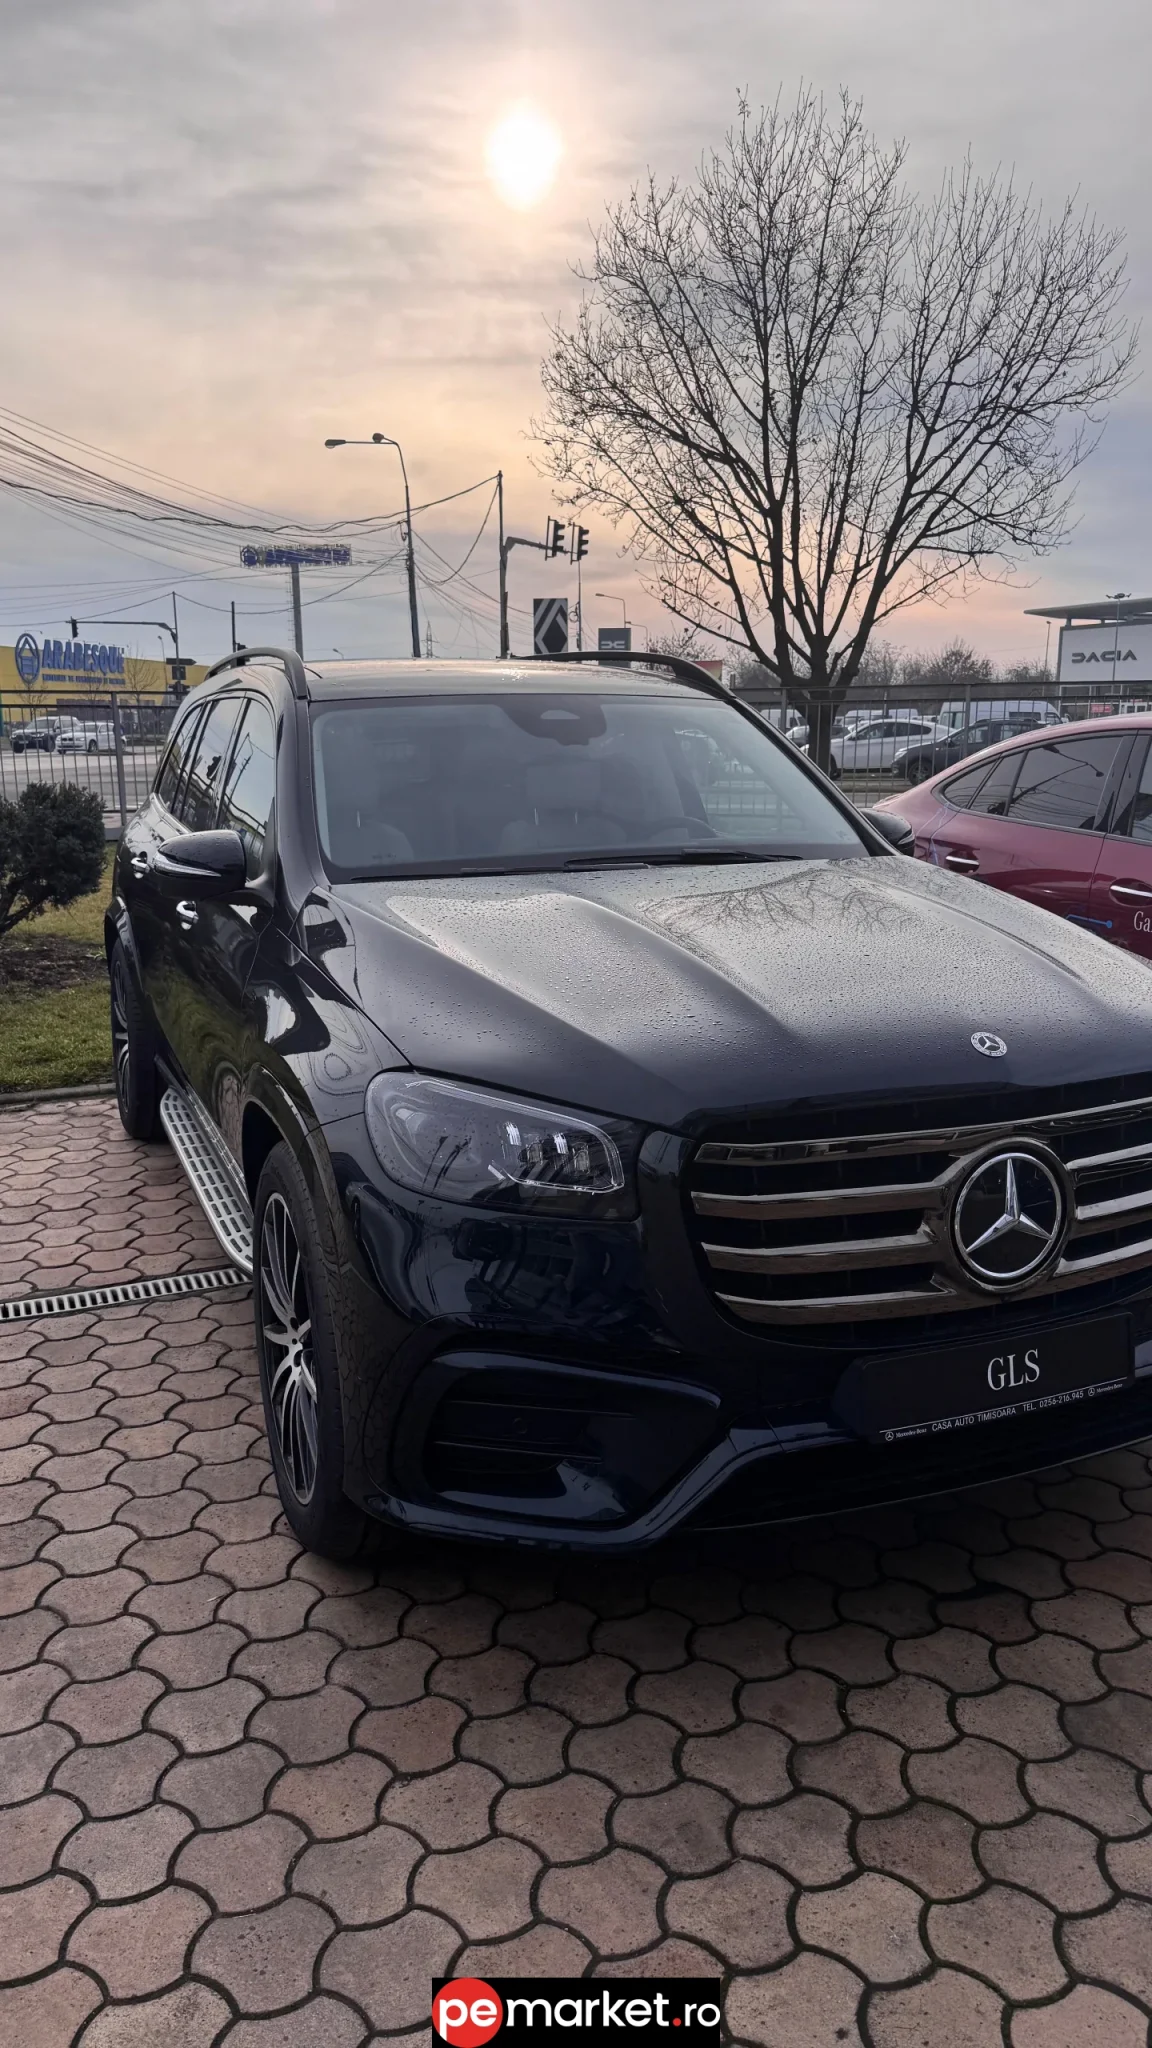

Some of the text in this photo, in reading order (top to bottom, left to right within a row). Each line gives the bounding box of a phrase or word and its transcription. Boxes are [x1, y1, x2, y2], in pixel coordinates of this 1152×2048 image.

[42, 639, 125, 676] ARABESQUE
[1071, 649, 1137, 664] DACIA
[987, 1348, 1040, 1391] GLS
[932, 1421, 953, 1432] CASA
[955, 1416, 975, 1427] AUTO
[977, 1407, 1017, 1422] TIMISOARA
[1023, 1403, 1037, 1412] TEL.
